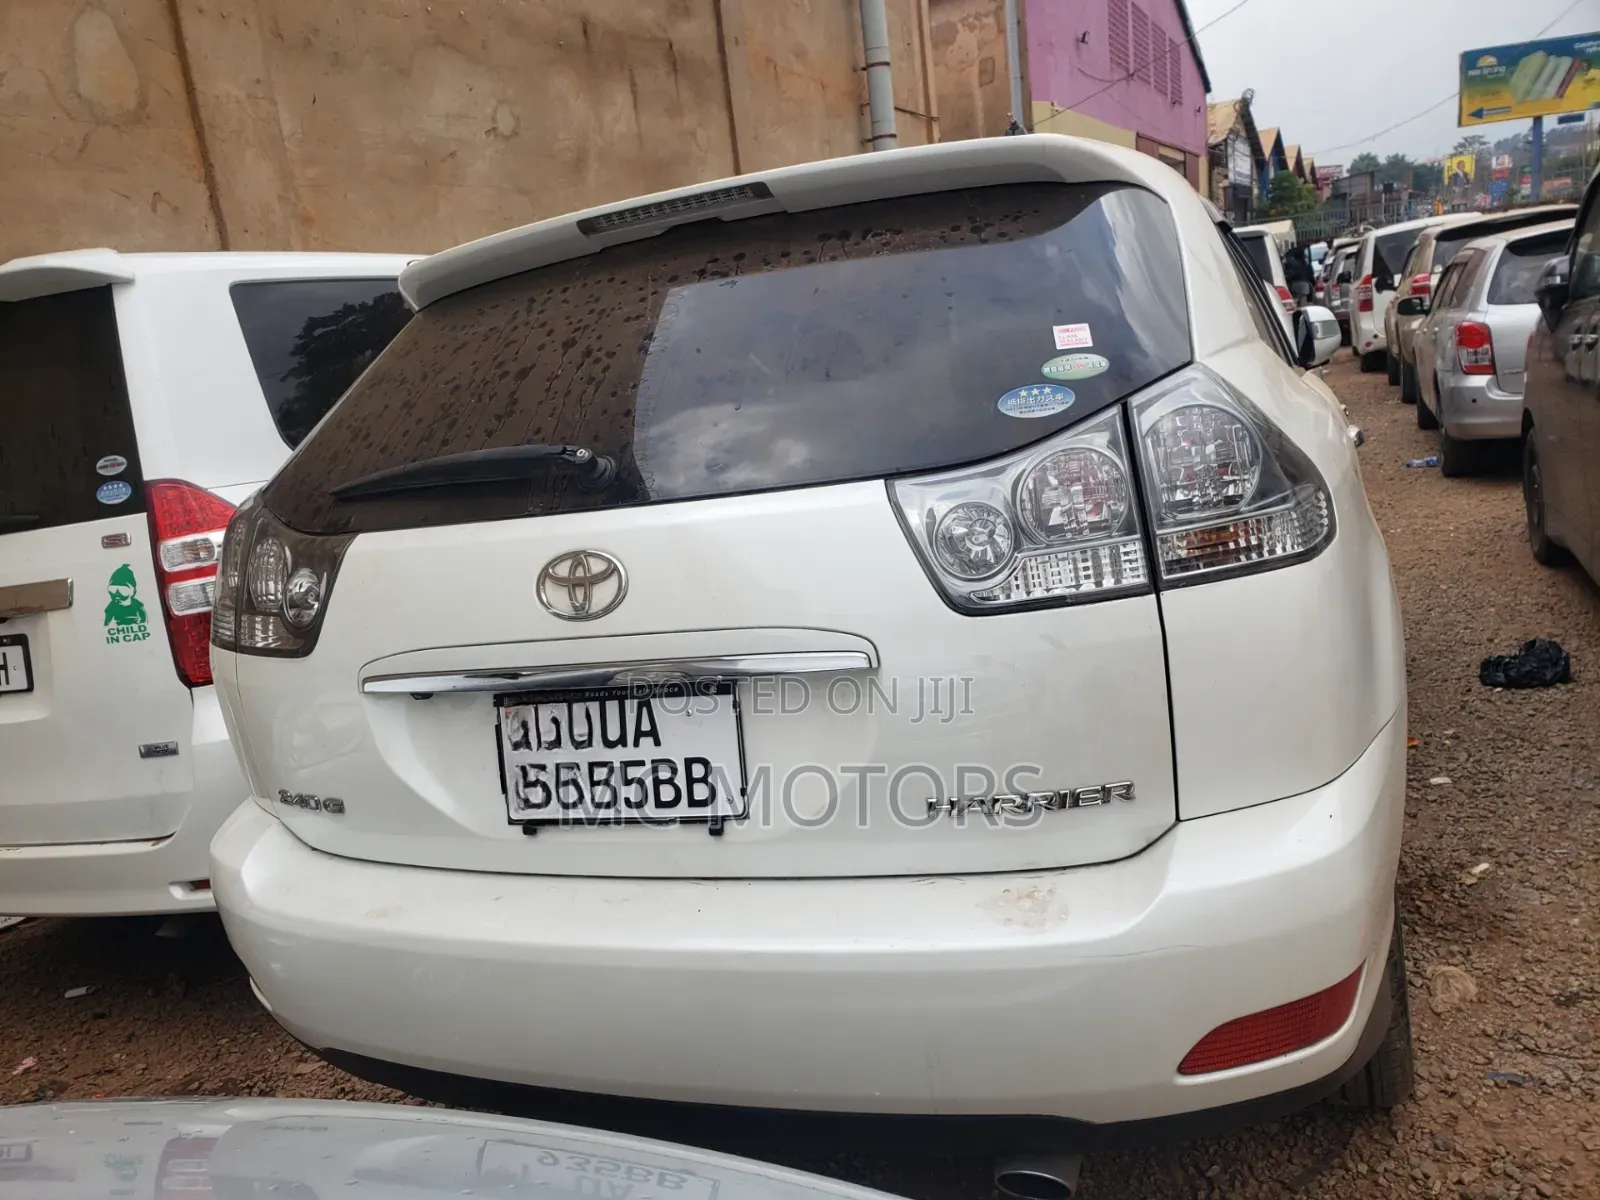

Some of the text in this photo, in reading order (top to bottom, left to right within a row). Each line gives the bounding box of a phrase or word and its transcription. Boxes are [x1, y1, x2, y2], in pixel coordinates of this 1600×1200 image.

[107, 625, 147, 636] CHILD
[105, 632, 151, 644] IN CAP
[926, 781, 1136, 818] HARRIER
